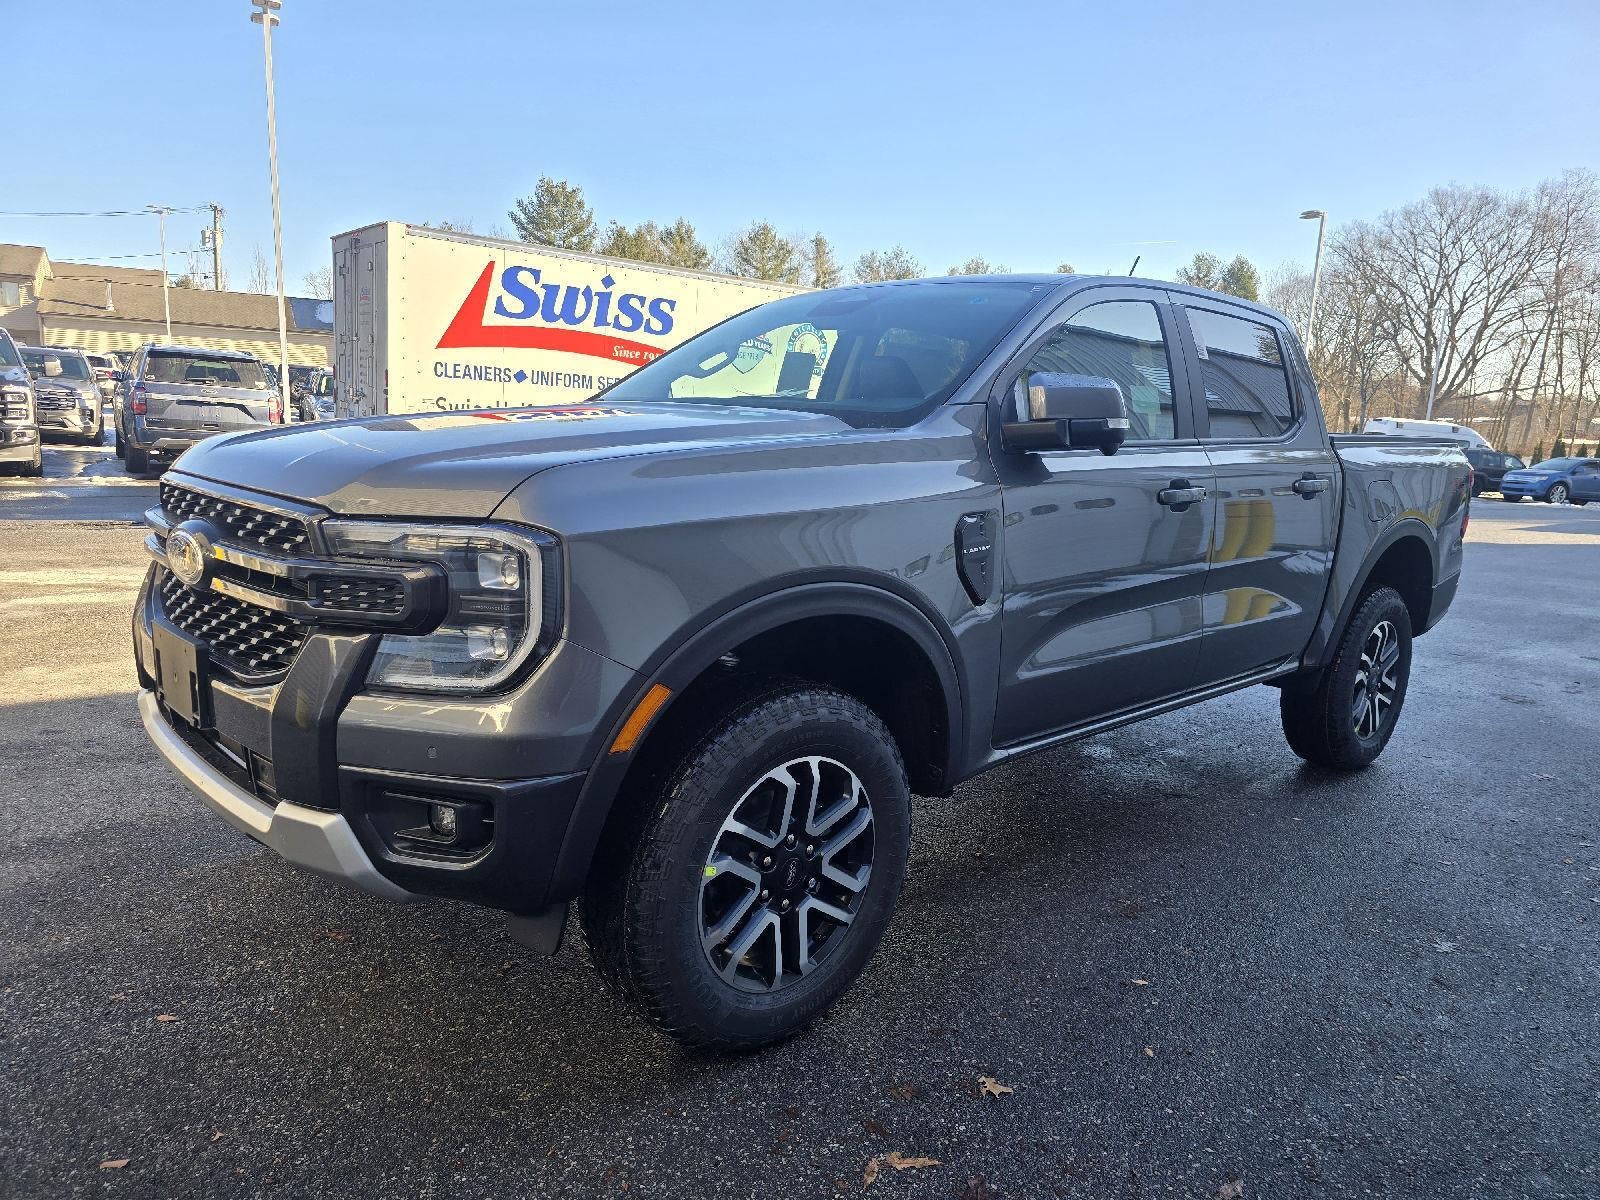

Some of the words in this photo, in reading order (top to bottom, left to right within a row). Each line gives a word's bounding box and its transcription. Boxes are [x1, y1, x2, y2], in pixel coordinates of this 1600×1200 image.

[494, 265, 677, 336] Swiss
[612, 345, 641, 359] Since
[433, 361, 512, 383] CLEANERS
[530, 369, 593, 389] UNIFORM
